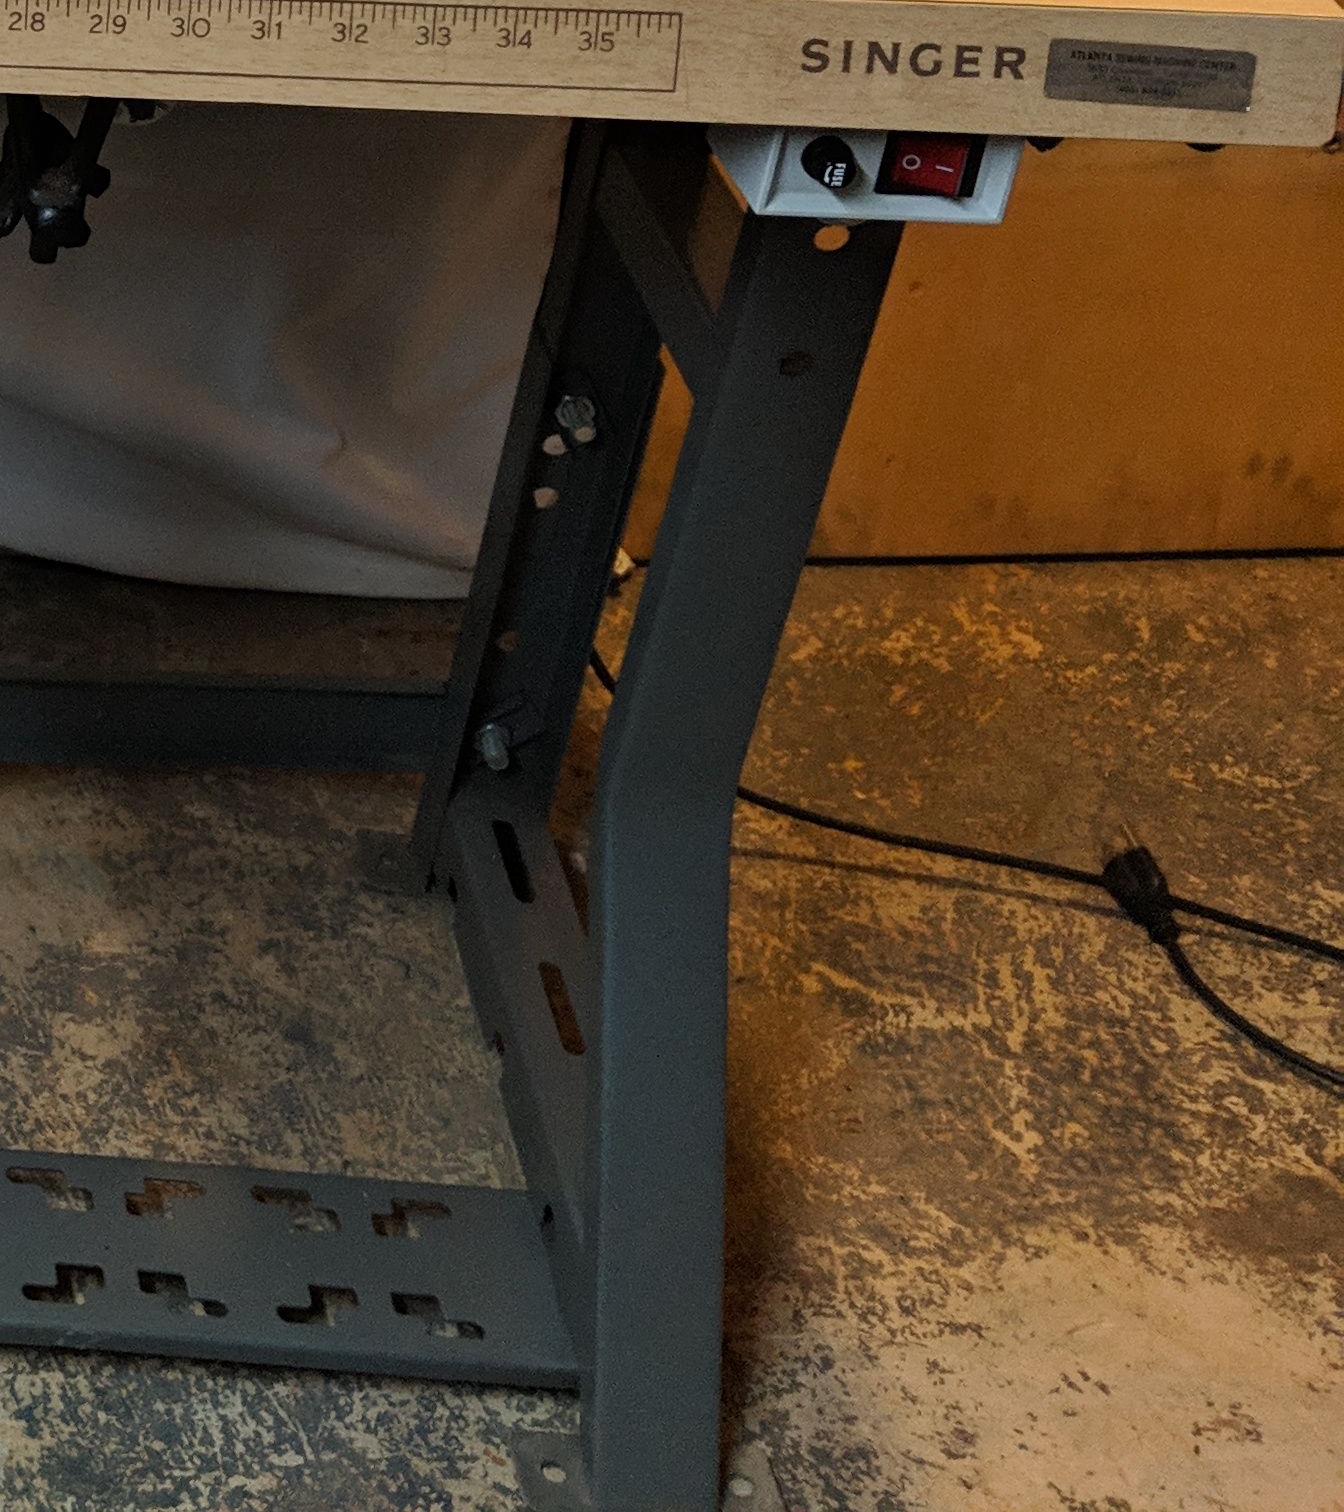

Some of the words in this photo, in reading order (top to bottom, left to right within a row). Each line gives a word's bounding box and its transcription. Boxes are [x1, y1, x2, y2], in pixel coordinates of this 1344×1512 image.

[7, 9, 45, 32] 28
[88, 12, 126, 34] 29
[171, 15, 211, 38] 30
[251, 18, 282, 40] 31
[331, 21, 369, 44] 32
[415, 23, 453, 46] 33
[496, 27, 533, 49] 34
[578, 30, 615, 53] 35
[800, 38, 1026, 80] SINGER
[829, 162, 848, 187] FUSE
